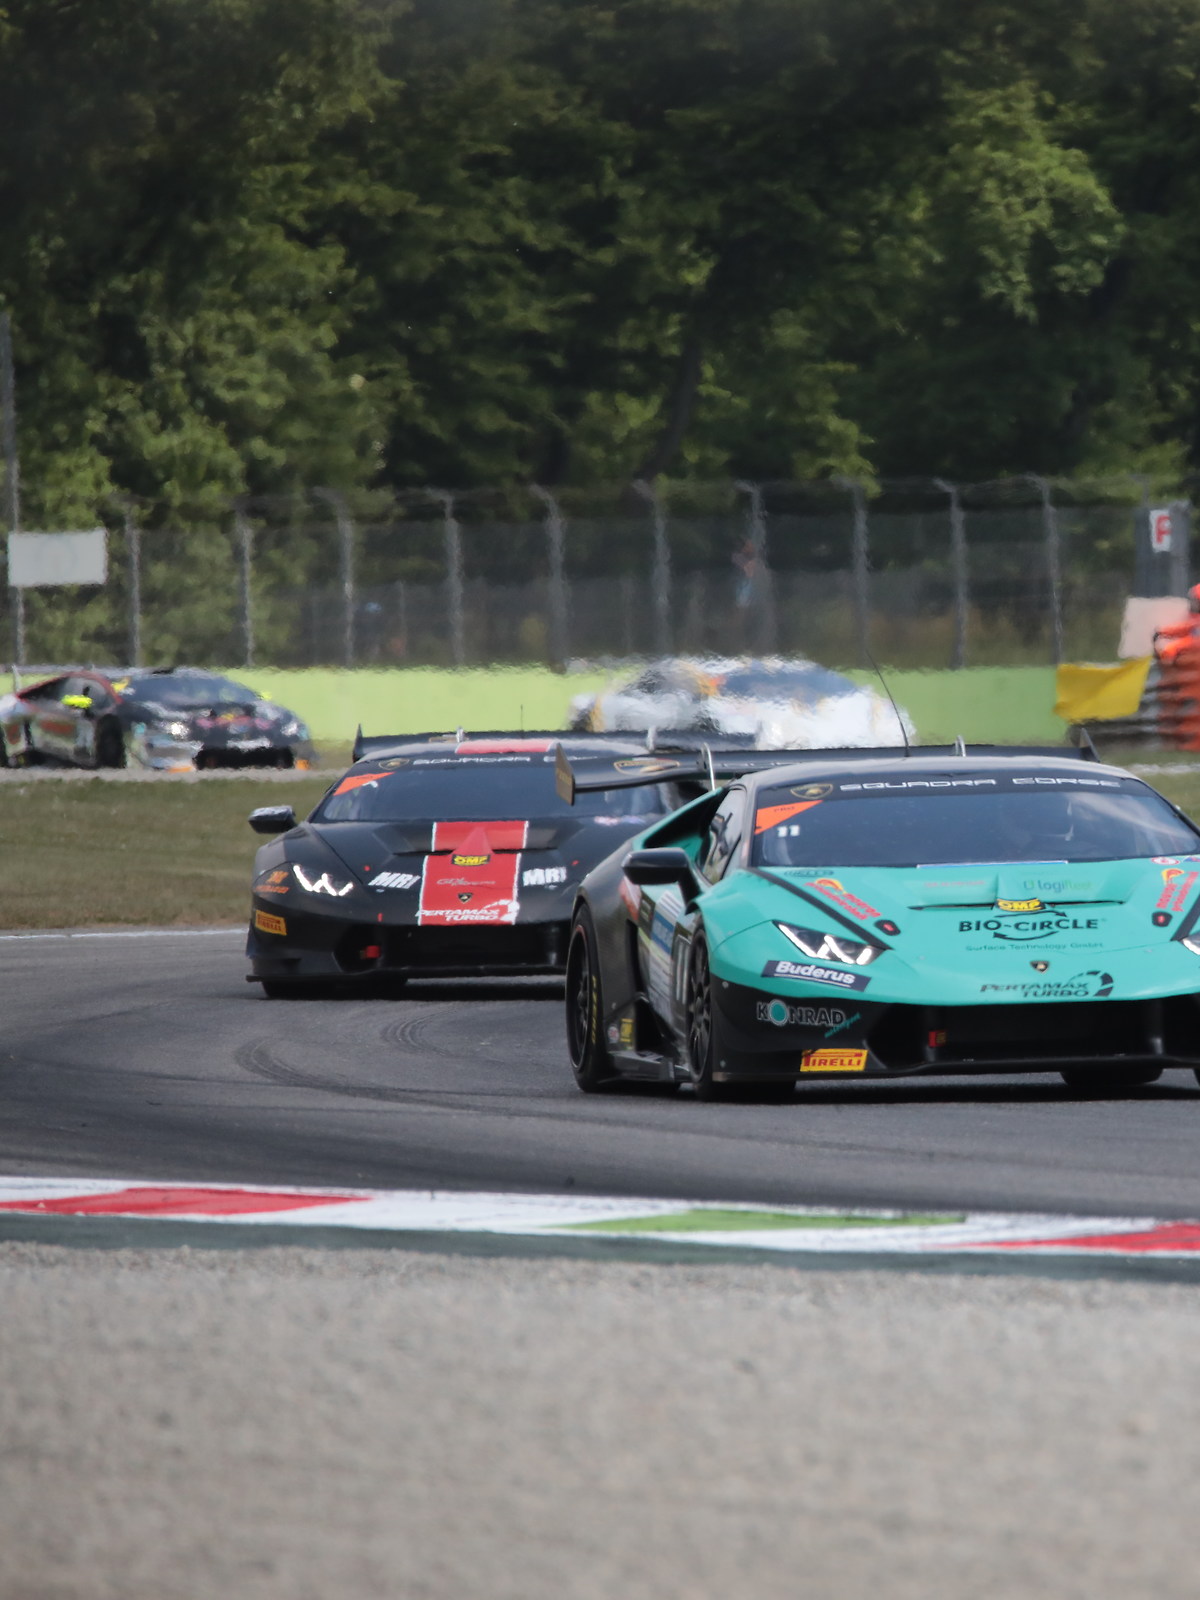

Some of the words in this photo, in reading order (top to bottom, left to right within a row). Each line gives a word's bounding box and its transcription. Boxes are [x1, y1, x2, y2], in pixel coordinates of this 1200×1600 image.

[839, 778, 997, 791] SQUADRA
[1012, 777, 1121, 788] CORSE
[776, 824, 800, 837] 11
[958, 918, 1099, 933] BIO-CIRCLE
[774, 960, 856, 985] Buderus
[756, 998, 846, 1027] KONRAD
[802, 1051, 864, 1068] PIRELLI
